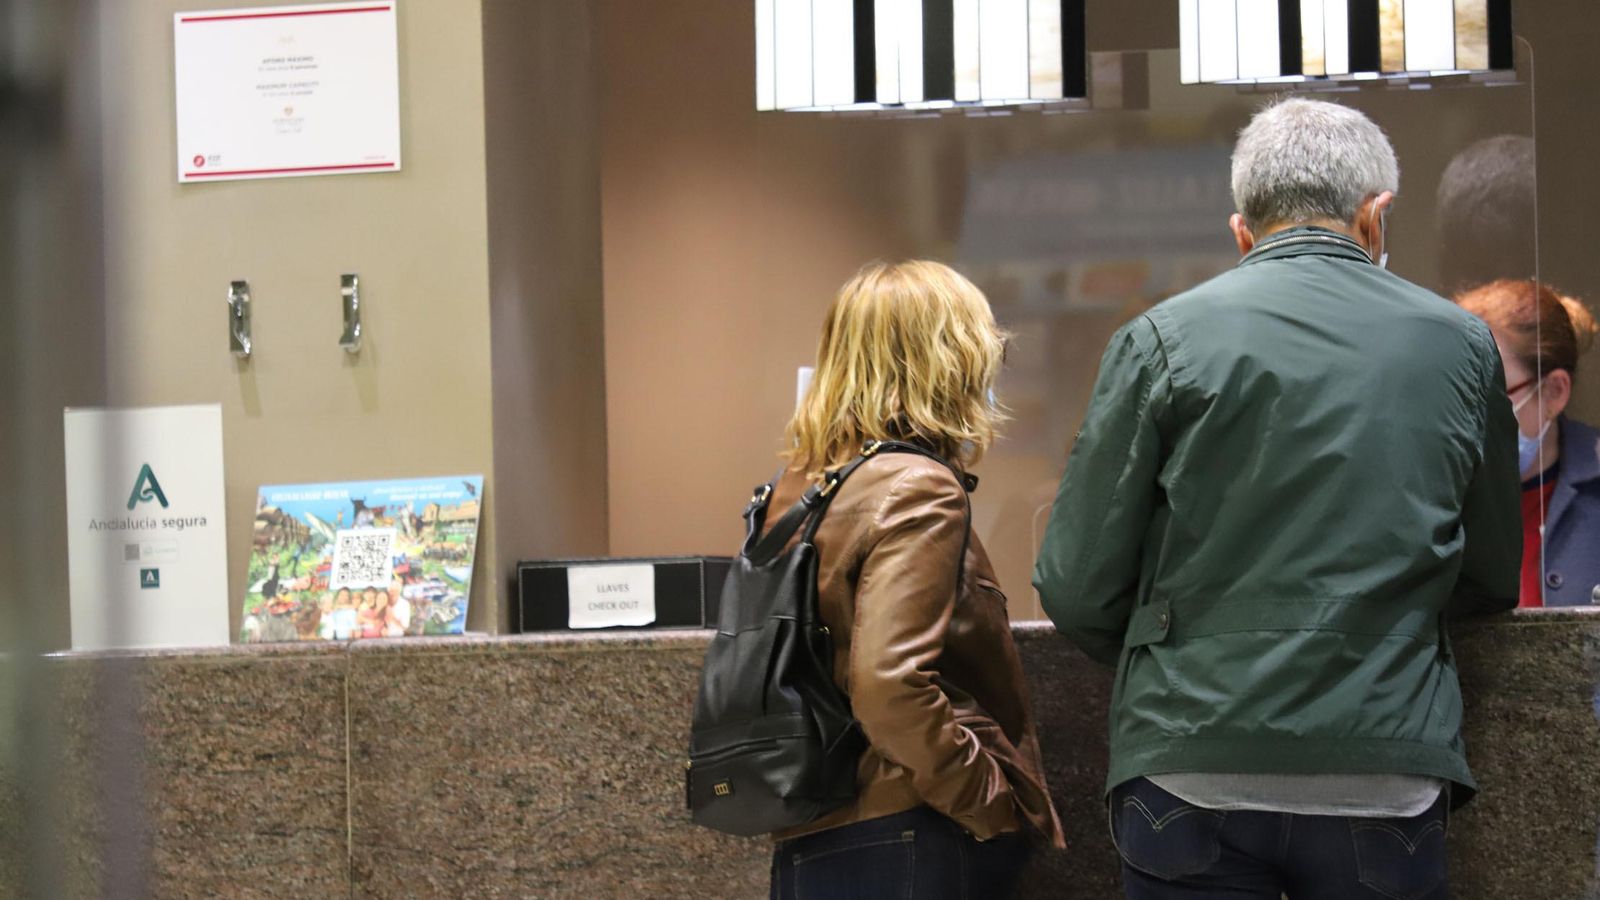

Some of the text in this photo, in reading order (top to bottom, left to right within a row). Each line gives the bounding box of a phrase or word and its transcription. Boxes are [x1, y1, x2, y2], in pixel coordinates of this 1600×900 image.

[161, 516, 207, 531] segura
[597, 583, 630, 593] LLAVES
[588, 600, 639, 611] CHECK OUT
